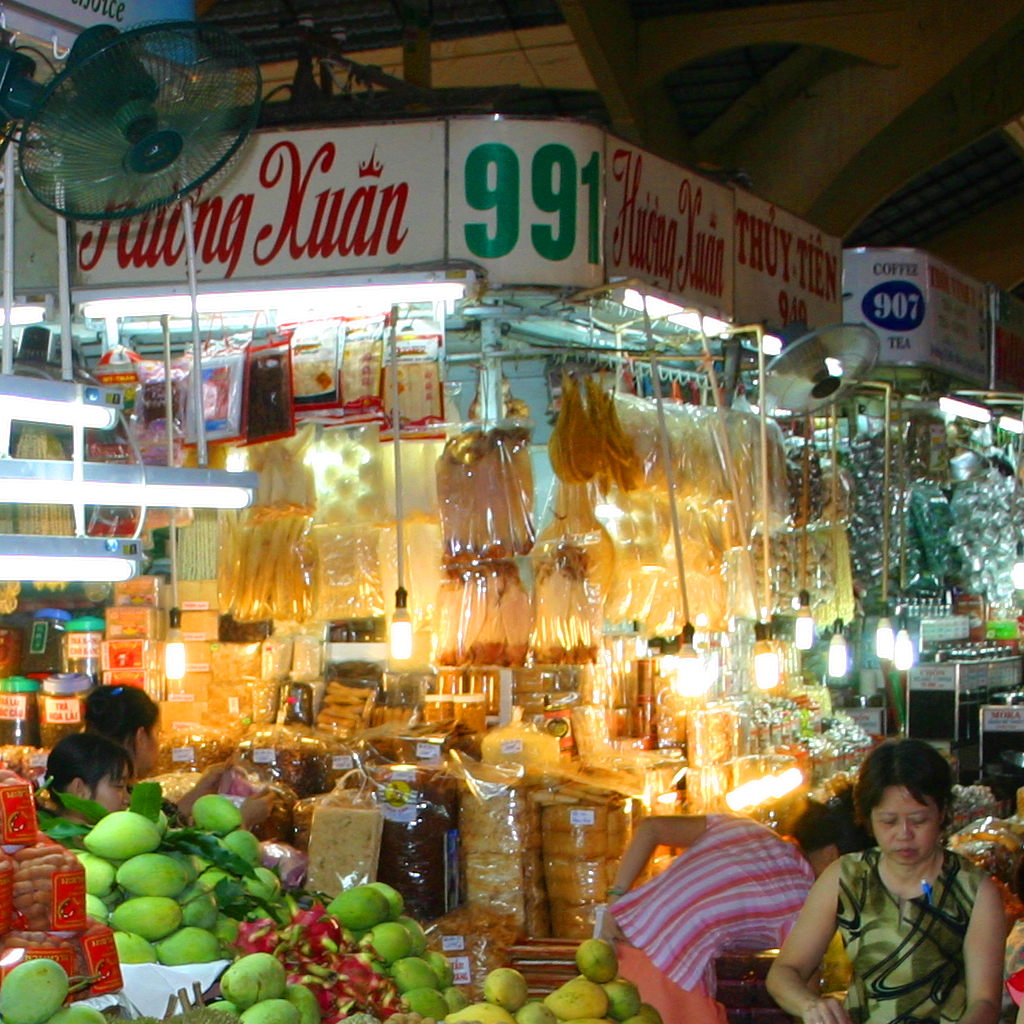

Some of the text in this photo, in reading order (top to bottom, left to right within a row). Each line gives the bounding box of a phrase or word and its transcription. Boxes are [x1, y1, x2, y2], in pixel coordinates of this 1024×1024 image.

[464, 143, 600, 265] 991
[873, 263, 919, 276] COFFEE
[873, 292, 920, 320] 907
[888, 337, 912, 349] TEA
